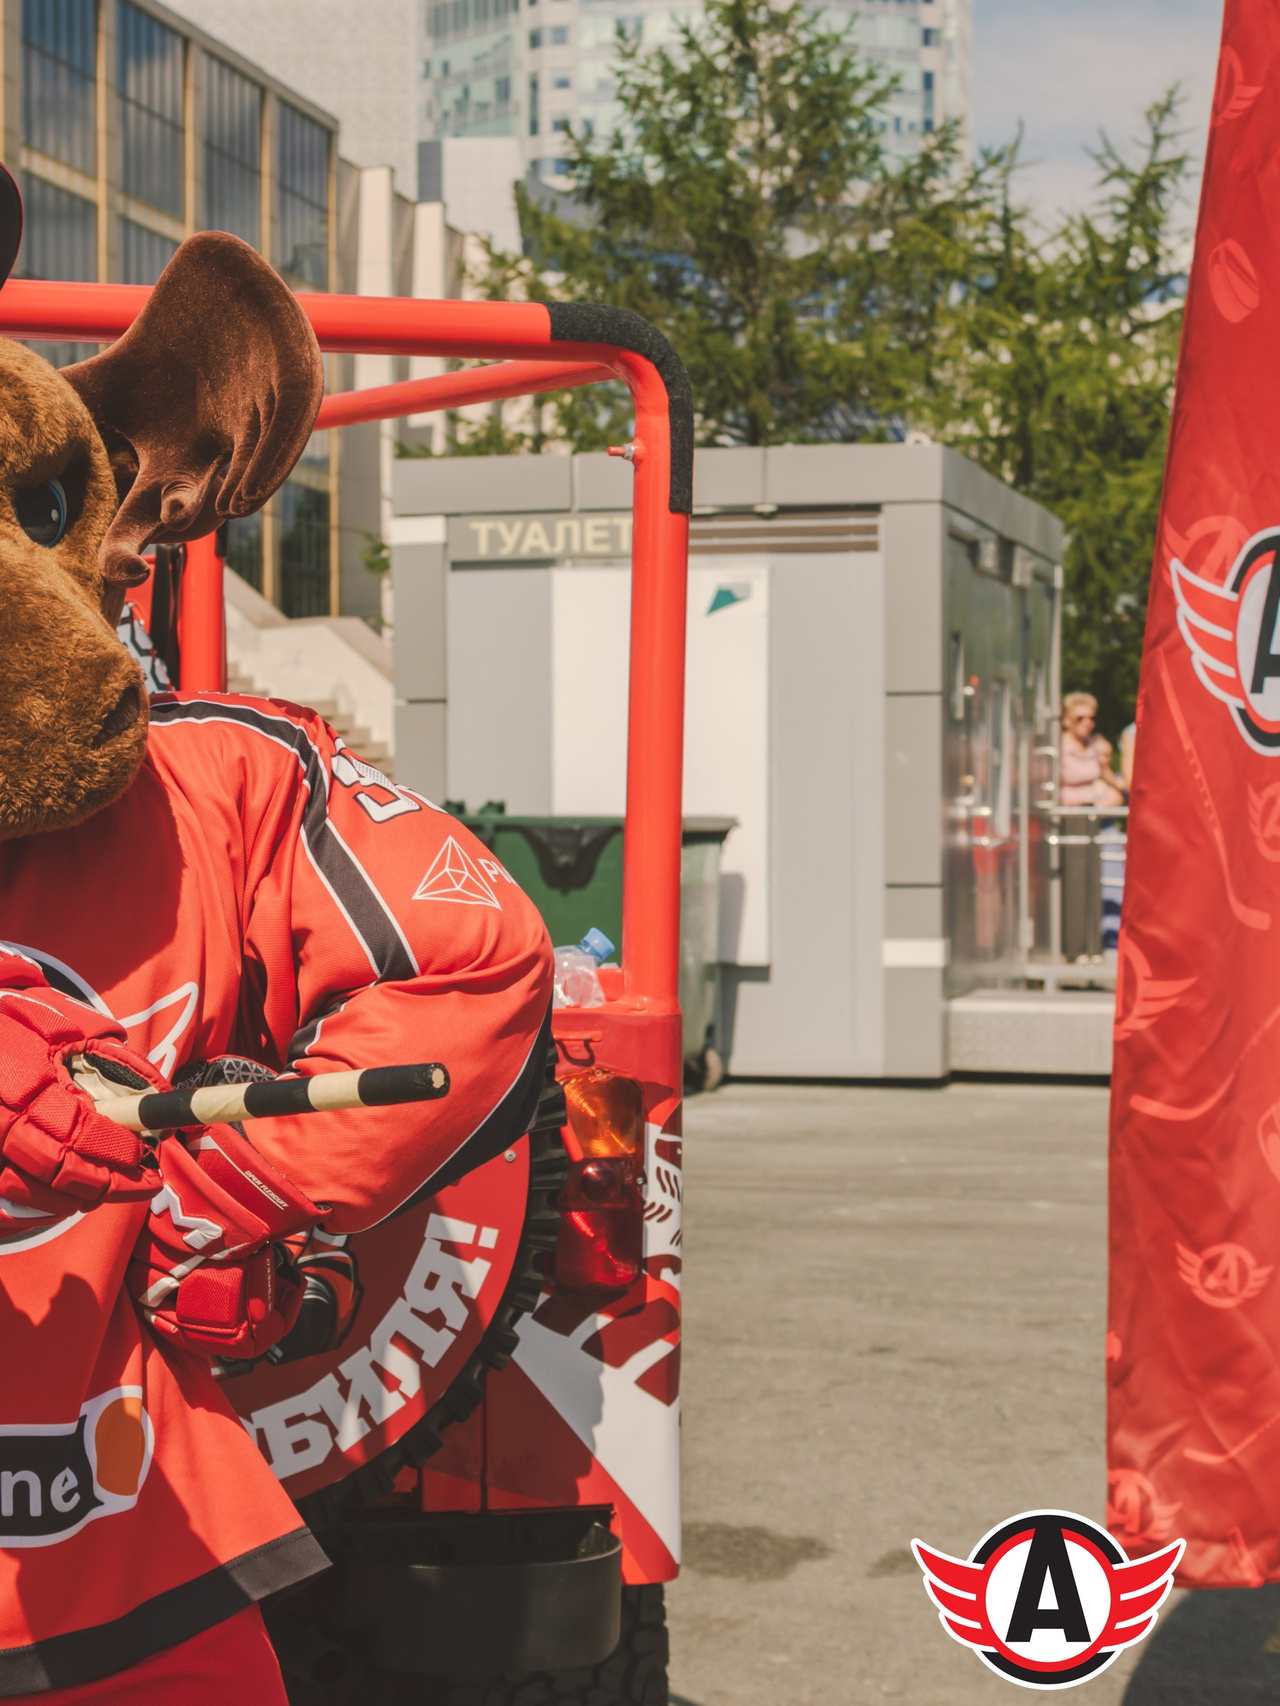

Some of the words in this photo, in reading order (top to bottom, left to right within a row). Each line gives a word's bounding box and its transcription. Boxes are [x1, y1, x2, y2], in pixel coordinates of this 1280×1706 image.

[470, 516, 634, 556] ТУАЛЕТ
[244, 1169, 263, 1188] OPEN
[260, 1182, 290, 1209] FLEXCUFF
[238, 1213, 500, 1480] БИЛЯ!
